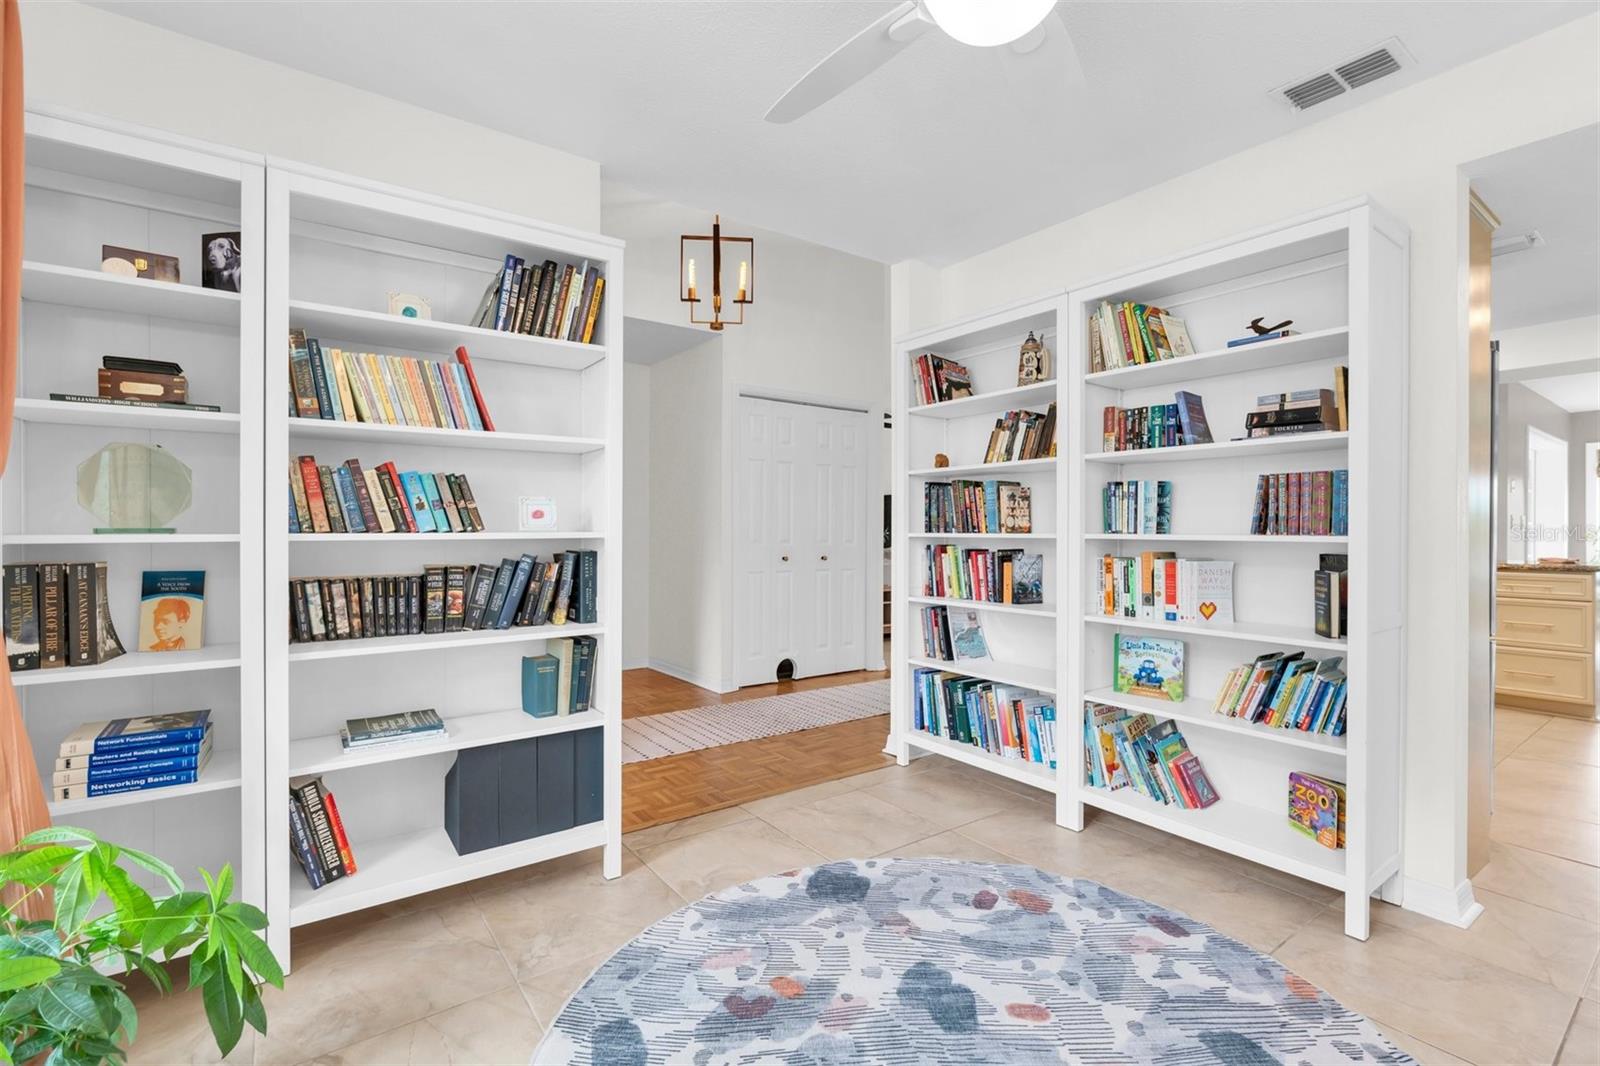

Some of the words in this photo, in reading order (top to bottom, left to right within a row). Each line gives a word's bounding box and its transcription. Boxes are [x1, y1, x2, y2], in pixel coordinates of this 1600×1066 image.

[10, 587, 21, 604] THE
[79, 581, 87, 591] AT
[22, 585, 33, 621] PARTING
[45, 586, 57, 618] PILLAR
[80, 592, 88, 630] CANAAN'S
[11, 606, 22, 643] WATERS
[46, 618, 58, 630] OF
[46, 632, 58, 652] FIRE
[80, 630, 89, 652] EDGE
[1126, 641, 1141, 649] Little
[1143, 642, 1155, 650] Blue
[1156, 643, 1178, 655] Truck's
[126, 734, 167, 743] Fundamentals
[91, 778, 146, 791] Networking
[147, 774, 176, 784] Basics
[1295, 784, 1329, 810] ZOO
[303, 784, 321, 812] ARNOLD
[312, 810, 340, 870] SCHWARZENEGGER
